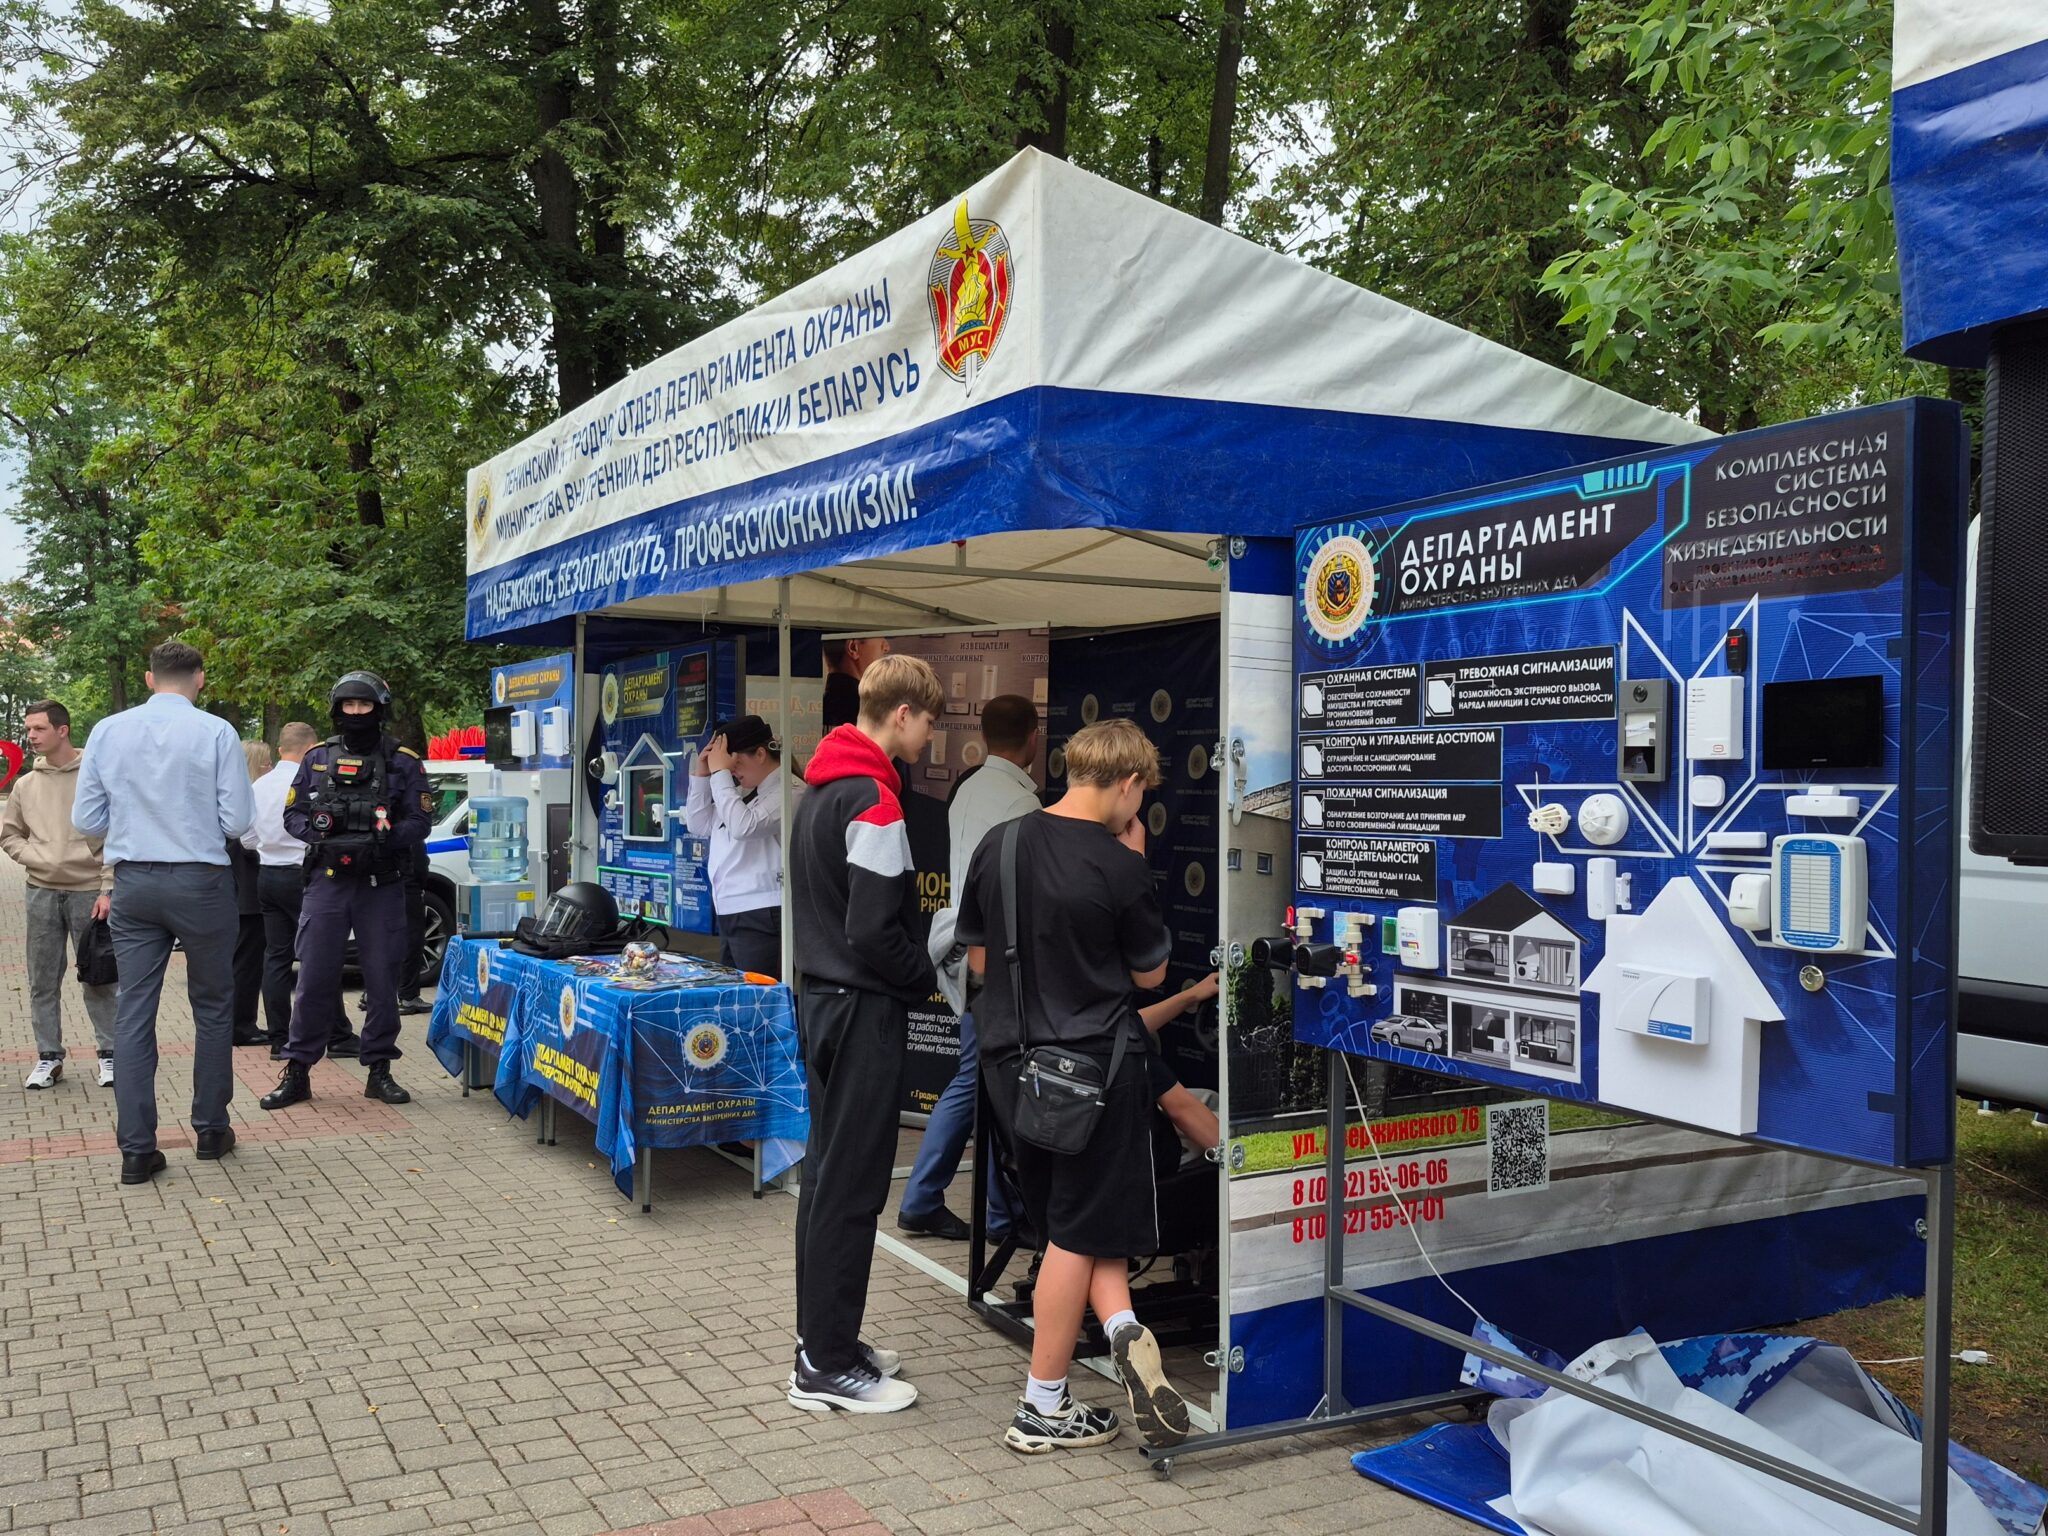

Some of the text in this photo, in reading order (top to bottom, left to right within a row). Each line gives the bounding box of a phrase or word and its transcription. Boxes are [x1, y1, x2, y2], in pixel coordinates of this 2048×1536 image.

[957, 331, 984, 353] МУС
[618, 386, 661, 437] ОТДЕЛ
[665, 326, 797, 423] ДЕПАРТАМЕНТА
[803, 277, 891, 358] ОХРАНЫ
[565, 450, 640, 513] ВНУТРЕННИХ
[642, 437, 673, 487] ДЕЛ
[674, 394, 791, 470] РЕСПУБЛИКИ
[798, 348, 920, 429] БЕЛАРУСЬ
[1715, 431, 1888, 481] КОМПЛЕКСНАЯ
[1775, 458, 1888, 494] СИСТЕМА
[1705, 483, 1887, 529] БЕЗОПАСНОСТИ
[486, 463, 918, 623] НАДЕЖНОСТЬ, БЕЗОПАСНОСТЬ, ПРОФЕССИОНАЛИЗМ!
[1400, 503, 1616, 570] ДЕПАРТАМЕНТ
[1667, 515, 1888, 564] ЖИЗНЕДЕЯТЕЛЬНОСТИ
[1400, 551, 1523, 595] ОХРАНЫ
[1552, 575, 1577, 591] ДЕЛ
[1327, 667, 1417, 685] ОХРАННАЯ СИСТЕМА
[1459, 656, 1613, 680] ТРЕВОЖНАЯ СИГНАЛИЗАЦИЯ
[1327, 688, 1411, 701] ОБЕСПЕЧЕНИЕ СОХРАННОСТИ
[1459, 683, 1600, 699] ВОЗМОЖНОСТЬ ЭКСТРЕННОГО ВЫЗОВА
[1327, 701, 1360, 710] ИМУЩЕСТВА
[1459, 694, 1613, 710] НАРЯДА МИЛИЦИИ В СЛУЧАЕ ОПАСНОСТИ
[1327, 709, 1373, 719] ПРОНИКНОВЕНИЯ
[1375, 717, 1397, 725] ОБЪЕКТ
[1326, 731, 1495, 747] КОНТРОЛЬ И УПРАВЛЕНИЕ ДОСТУПОМ
[1370, 753, 1436, 762] САНКЦИОНИРОВАНИЕ
[1326, 764, 1411, 773] ДОСТУПА ПОСТОРОННИХ ЛИЦ
[1326, 787, 1447, 799] ПОЖАРНАЯ СИГНАЛИЗАЦИЯ
[1326, 811, 1466, 821] ОБНАРУЖЕНИЕ ВОЗГОРАНИЕ ДЛЯ ПРИНЯТИЯ МЕР
[1346, 820, 1396, 830] СВОЕВРЕМЕННОЙ
[1397, 822, 1440, 831] ЛИКВИДАЦИИ
[1326, 839, 1430, 853] КОНТРОЛЬ ПАРАМЕТРОВ
[1326, 850, 1419, 864] ЖИЗНЕДЕЯТЕЛЬНОСТИ
[1326, 868, 1348, 876] ЗАЩИТА
[1357, 870, 1378, 878] УТЕЧКИ
[1379, 871, 1398, 880] ВОДЫ
[1399, 872, 1403, 880] И
[1404, 873, 1423, 882] ГАЗА,
[1326, 878, 1379, 887] ИНФОРМИРОВАНИЕ
[1326, 884, 1398, 896] ЗАИНТЕРЕСОВАННЫХ ЛИЦ
[648, 1097, 756, 1115] ДЕПАРТАМЕНТ ОХРАНЫ
[646, 1116, 700, 1126] МИНИСТЕРСТВА
[742, 1110, 756, 1118] ДЕЛ
[1292, 1106, 1480, 1159] ул. ержинского 76
[1292, 1158, 1448, 1206] 8 (02) 55-06-06
[1292, 1195, 1445, 1243] 8 (02) 55-97-01
